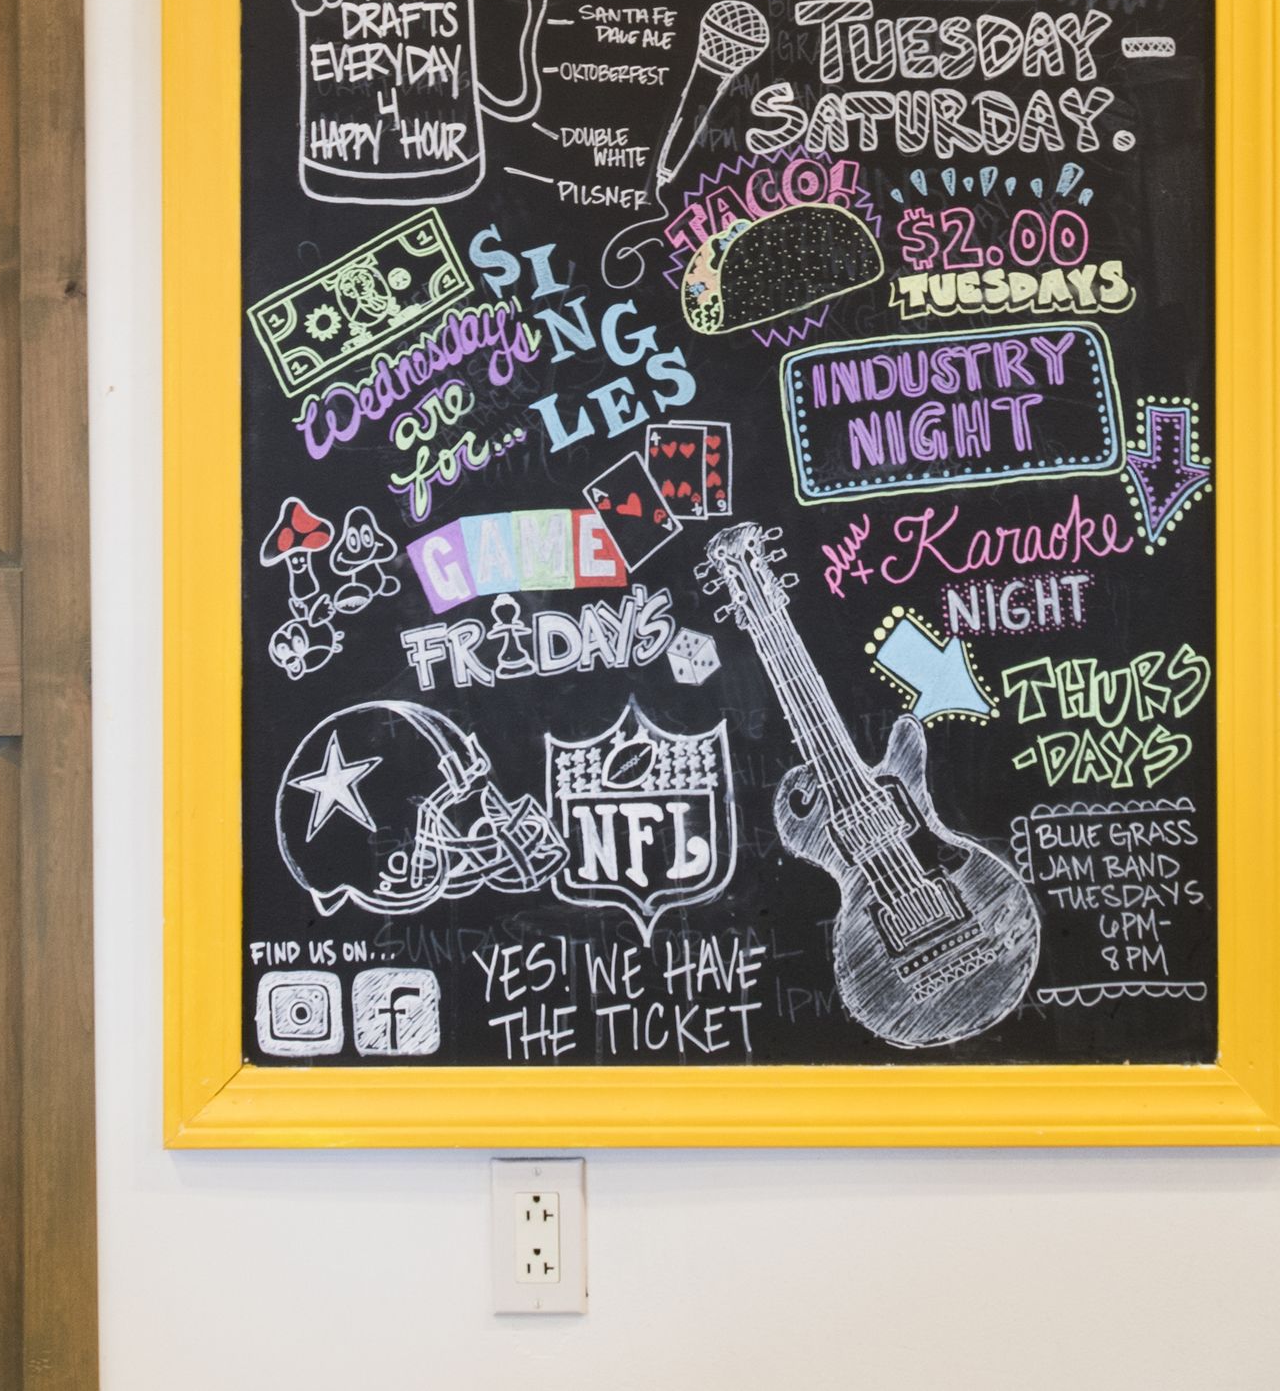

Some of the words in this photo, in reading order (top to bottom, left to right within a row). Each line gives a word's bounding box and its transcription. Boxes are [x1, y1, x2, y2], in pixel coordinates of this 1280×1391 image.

[341, 2, 458, 39] DRAFTS
[310, 42, 462, 99] EVERYDAY
[559, 62, 670, 85] OKTOBERFEST
[377, 88, 401, 131] 4
[560, 127, 629, 147] DOUBLE
[746, 82, 1136, 159] SATURDAY.
[310, 119, 382, 165] HAPPY
[400, 118, 469, 163] HOUR
[594, 146, 650, 168] WHITE
[557, 180, 652, 210] PILSNER
[664, 159, 860, 252] TACO!
[897, 207, 1089, 270] $2.00
[892, 261, 1132, 313] TUESDAYS
[812, 332, 1075, 408] INDUSTRY
[394, 383, 474, 450] are
[848, 394, 1043, 469] NIGHT
[422, 513, 617, 601] GAME
[822, 514, 871, 598] plus
[881, 494, 1134, 585] Karaoke
[946, 574, 1090, 634] NIGHT
[1001, 644, 1211, 728] THURS
[572, 802, 710, 887] NFL
[1035, 824, 1103, 849] BLUE
[1109, 819, 1199, 852] GRASS
[1039, 855, 1095, 882] JAM
[1102, 852, 1180, 882] BAND
[1047, 880, 1205, 910] TUESDAYS
[249, 941, 301, 965] FIND
[308, 939, 338, 966] US
[472, 935, 570, 1002] YES!
[585, 943, 645, 999] WE
[663, 935, 767, 1001] HAVE
[488, 1003, 578, 1060] THE
[596, 1002, 762, 1055] TICKET
